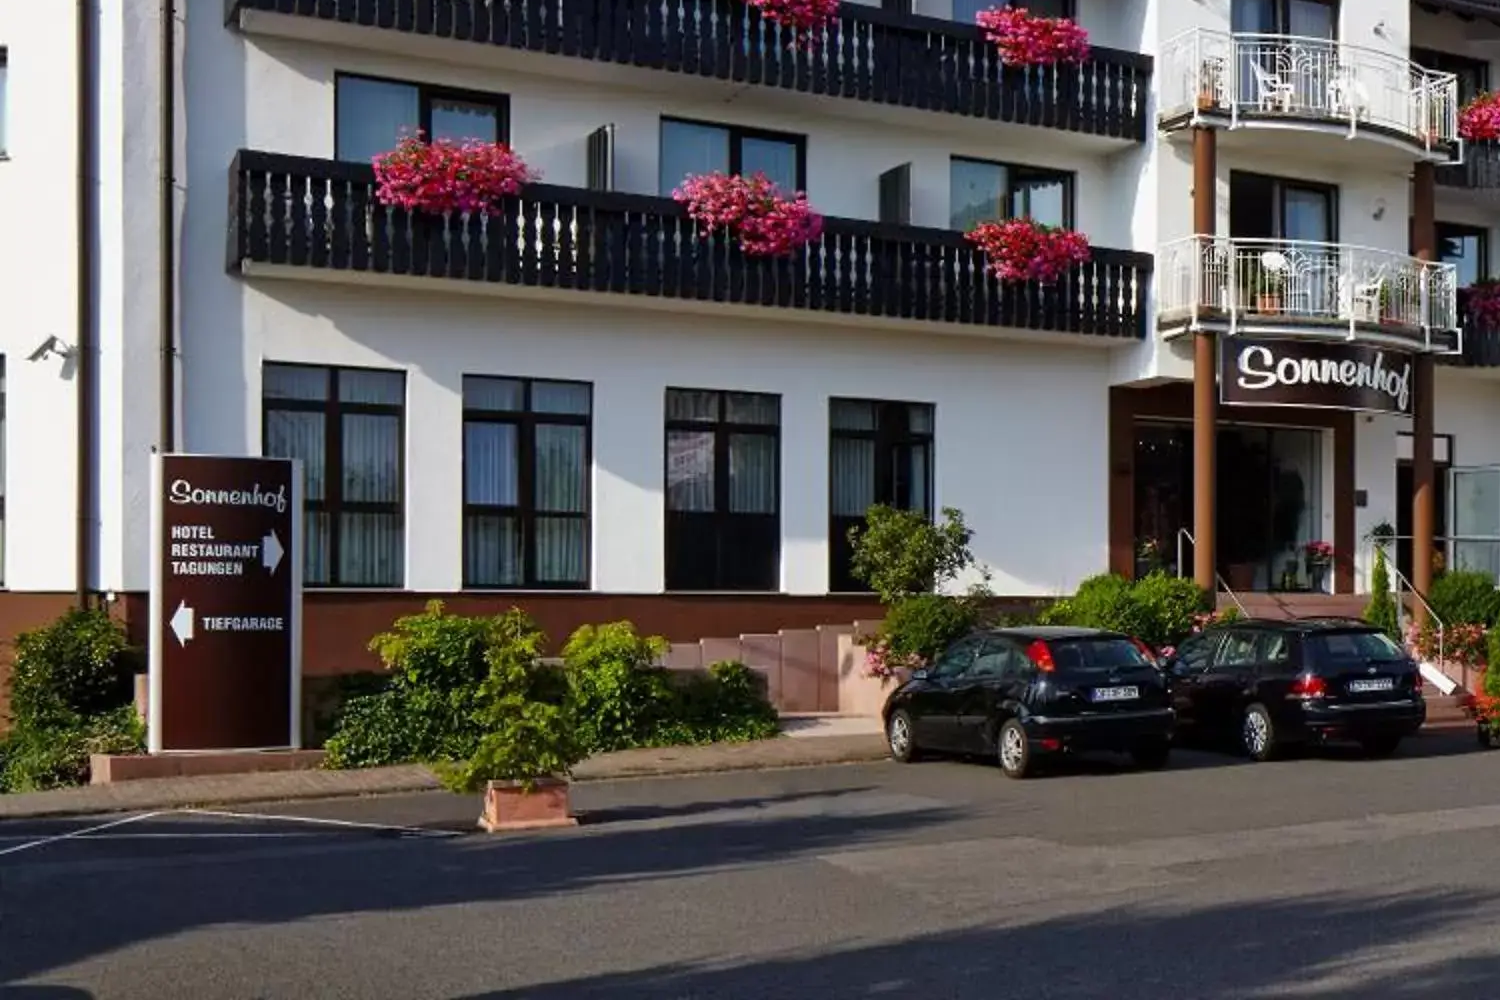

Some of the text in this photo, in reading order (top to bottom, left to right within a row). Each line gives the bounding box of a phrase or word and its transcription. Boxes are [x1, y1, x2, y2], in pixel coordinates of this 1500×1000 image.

[1237, 345, 1411, 411] Sonnenhof
[169, 479, 287, 513] Sonnenhof
[171, 525, 215, 539] HOTEL
[171, 544, 259, 557] RESTAURANT
[171, 561, 244, 575] TAGUNGEN
[203, 617, 284, 631] TIEFGARAGE
